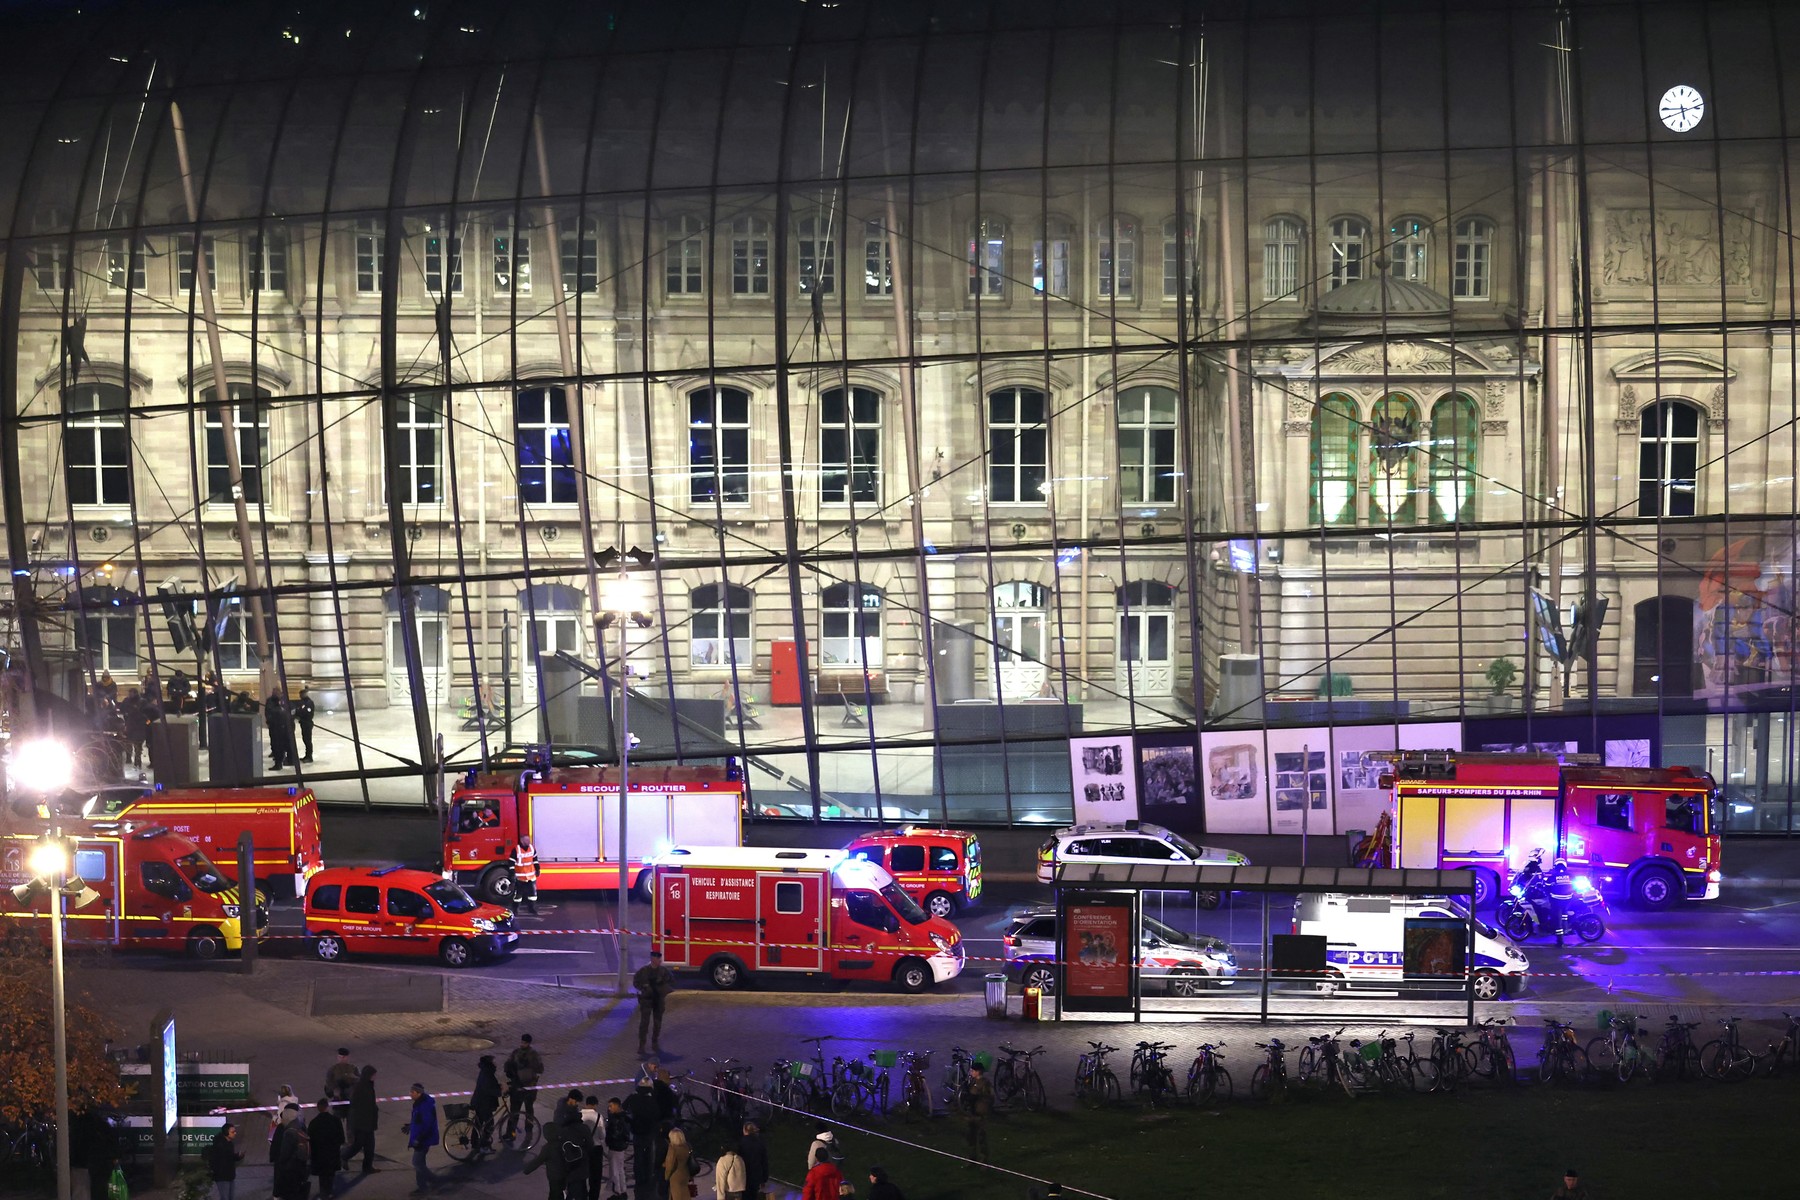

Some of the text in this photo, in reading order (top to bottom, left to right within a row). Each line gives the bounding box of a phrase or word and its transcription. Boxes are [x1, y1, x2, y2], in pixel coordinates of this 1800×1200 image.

[692, 878, 755, 887] VEHICULE D'ASSISTANCE
[671, 890, 680, 899] 18
[706, 891, 740, 900] RESPIRATOIRE
[1349, 952, 1403, 964] POLI
[219, 1079, 245, 1088] VÉLOS
[181, 1133, 215, 1142] DE VÉLO
